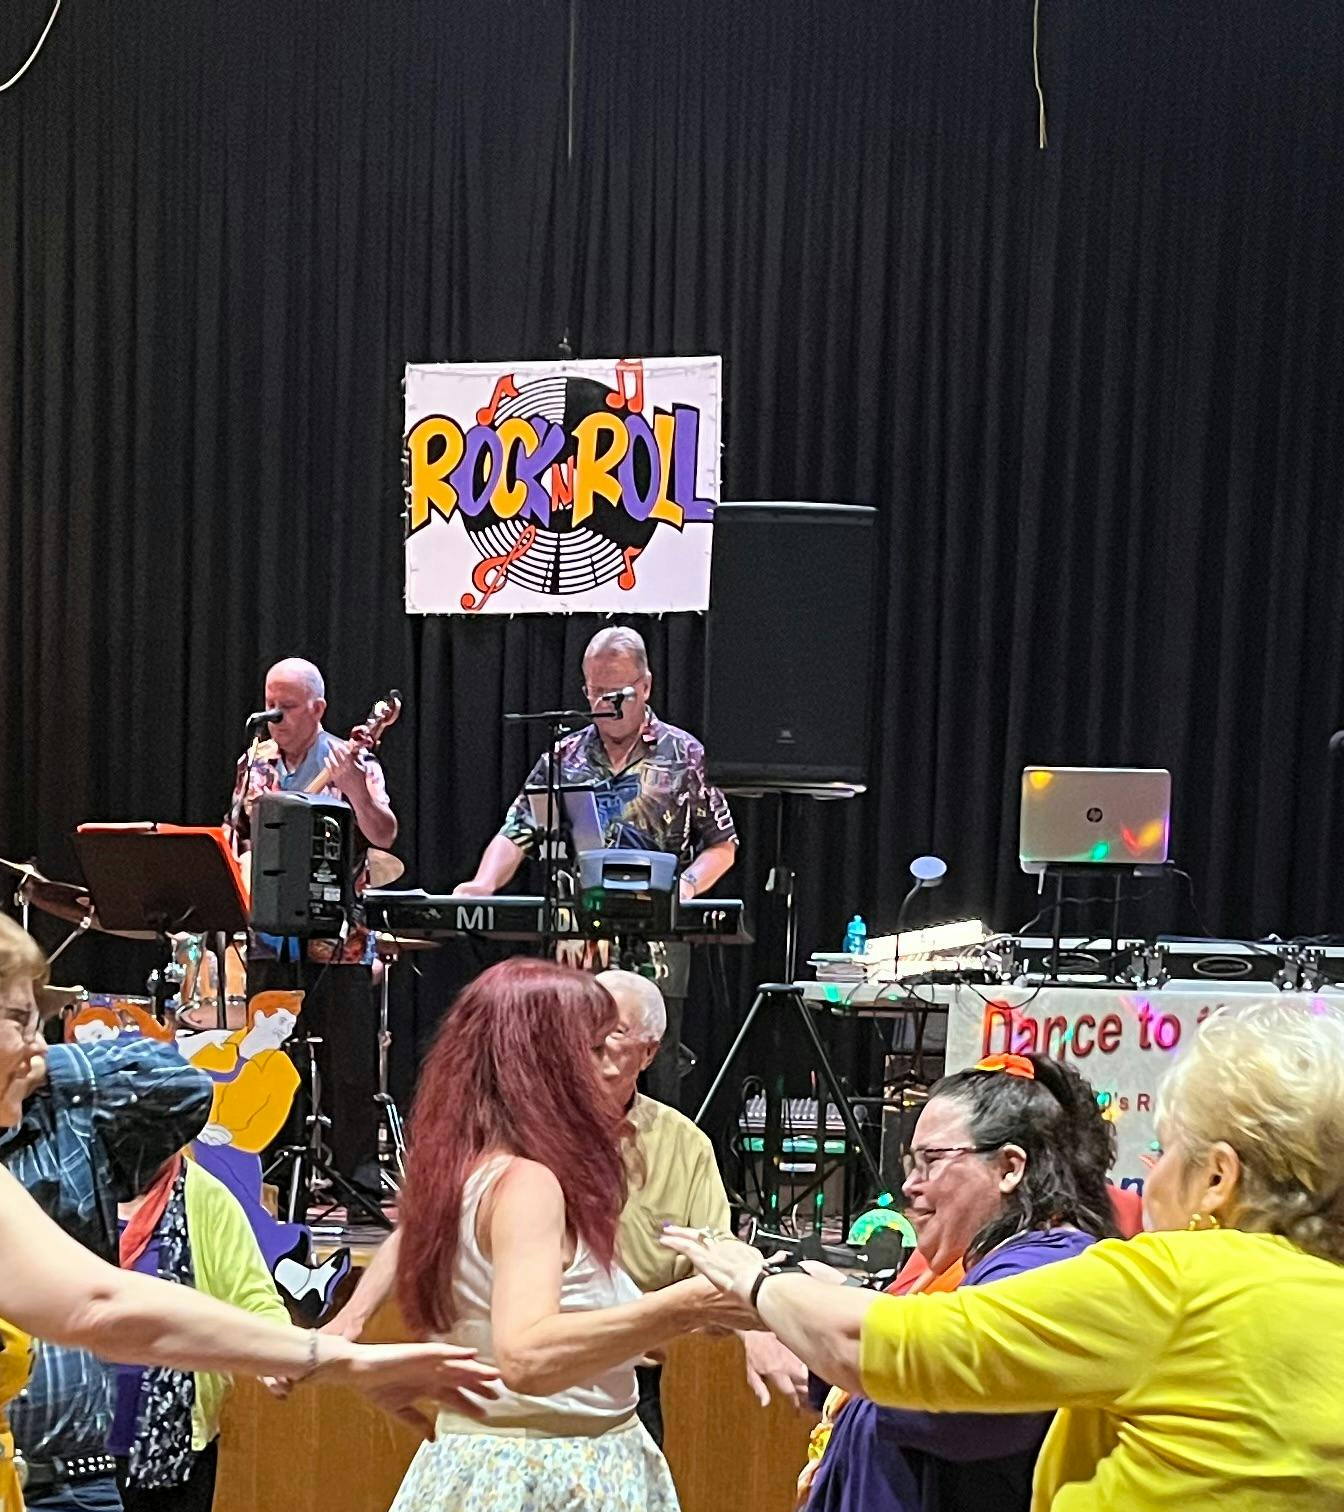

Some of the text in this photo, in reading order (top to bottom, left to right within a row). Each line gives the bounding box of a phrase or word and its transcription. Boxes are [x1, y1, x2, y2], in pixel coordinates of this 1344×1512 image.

[407, 415, 565, 531] ROCK
[570, 403, 716, 533] ROLL
[982, 1000, 1182, 1062] Dance to
